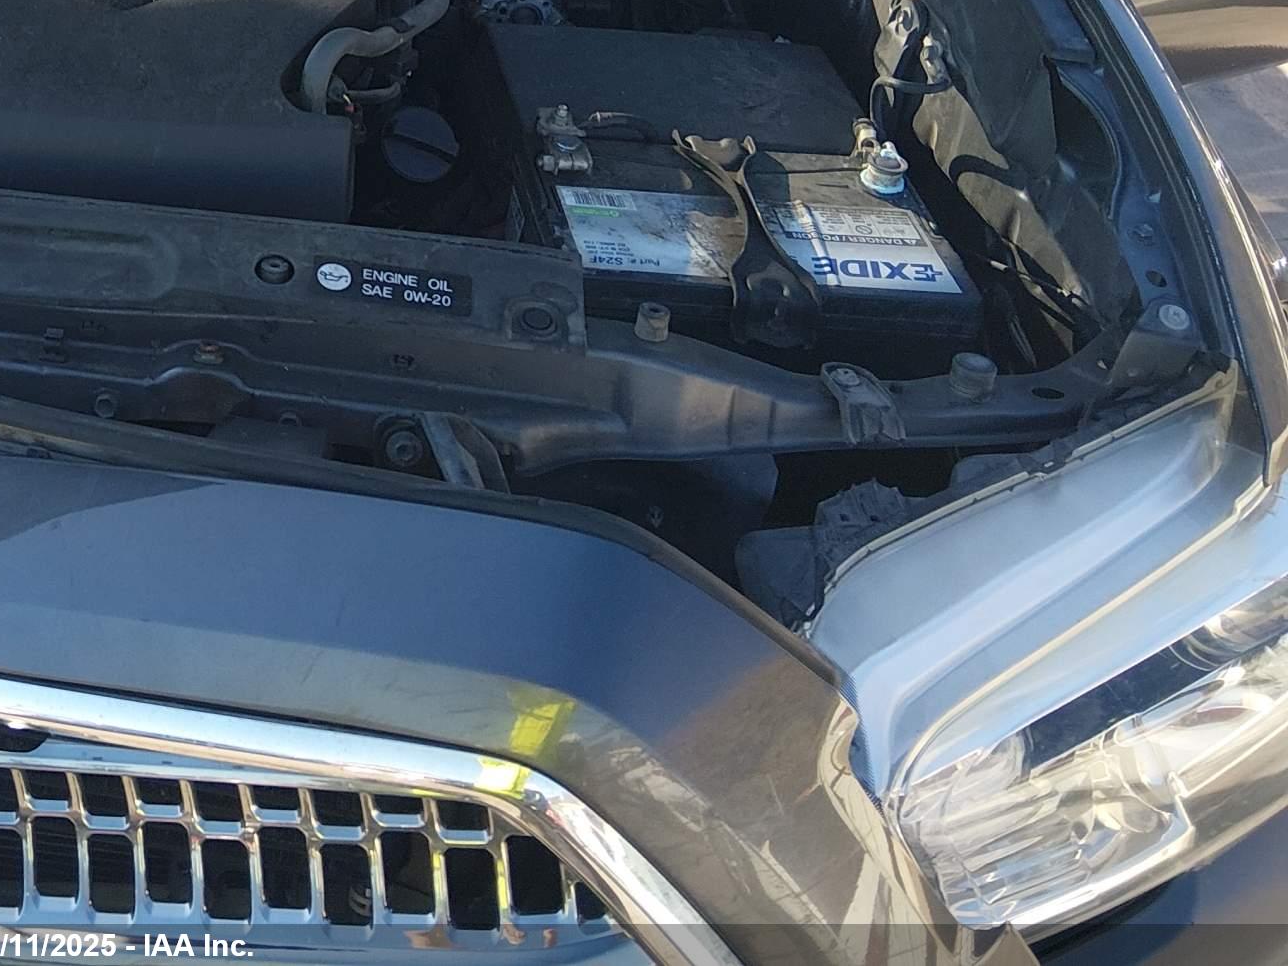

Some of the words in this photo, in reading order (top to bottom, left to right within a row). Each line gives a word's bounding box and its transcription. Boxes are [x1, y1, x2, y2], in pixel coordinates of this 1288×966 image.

[847, 235, 903, 246] DANGER
[590, 255, 624, 266] S24F
[640, 258, 660, 266] Part
[811, 256, 942, 283] EXIDE
[362, 268, 418, 287] ENGINE
[428, 278, 453, 292] OIL
[362, 283, 393, 298] SAE
[403, 290, 451, 307] 0W-20
